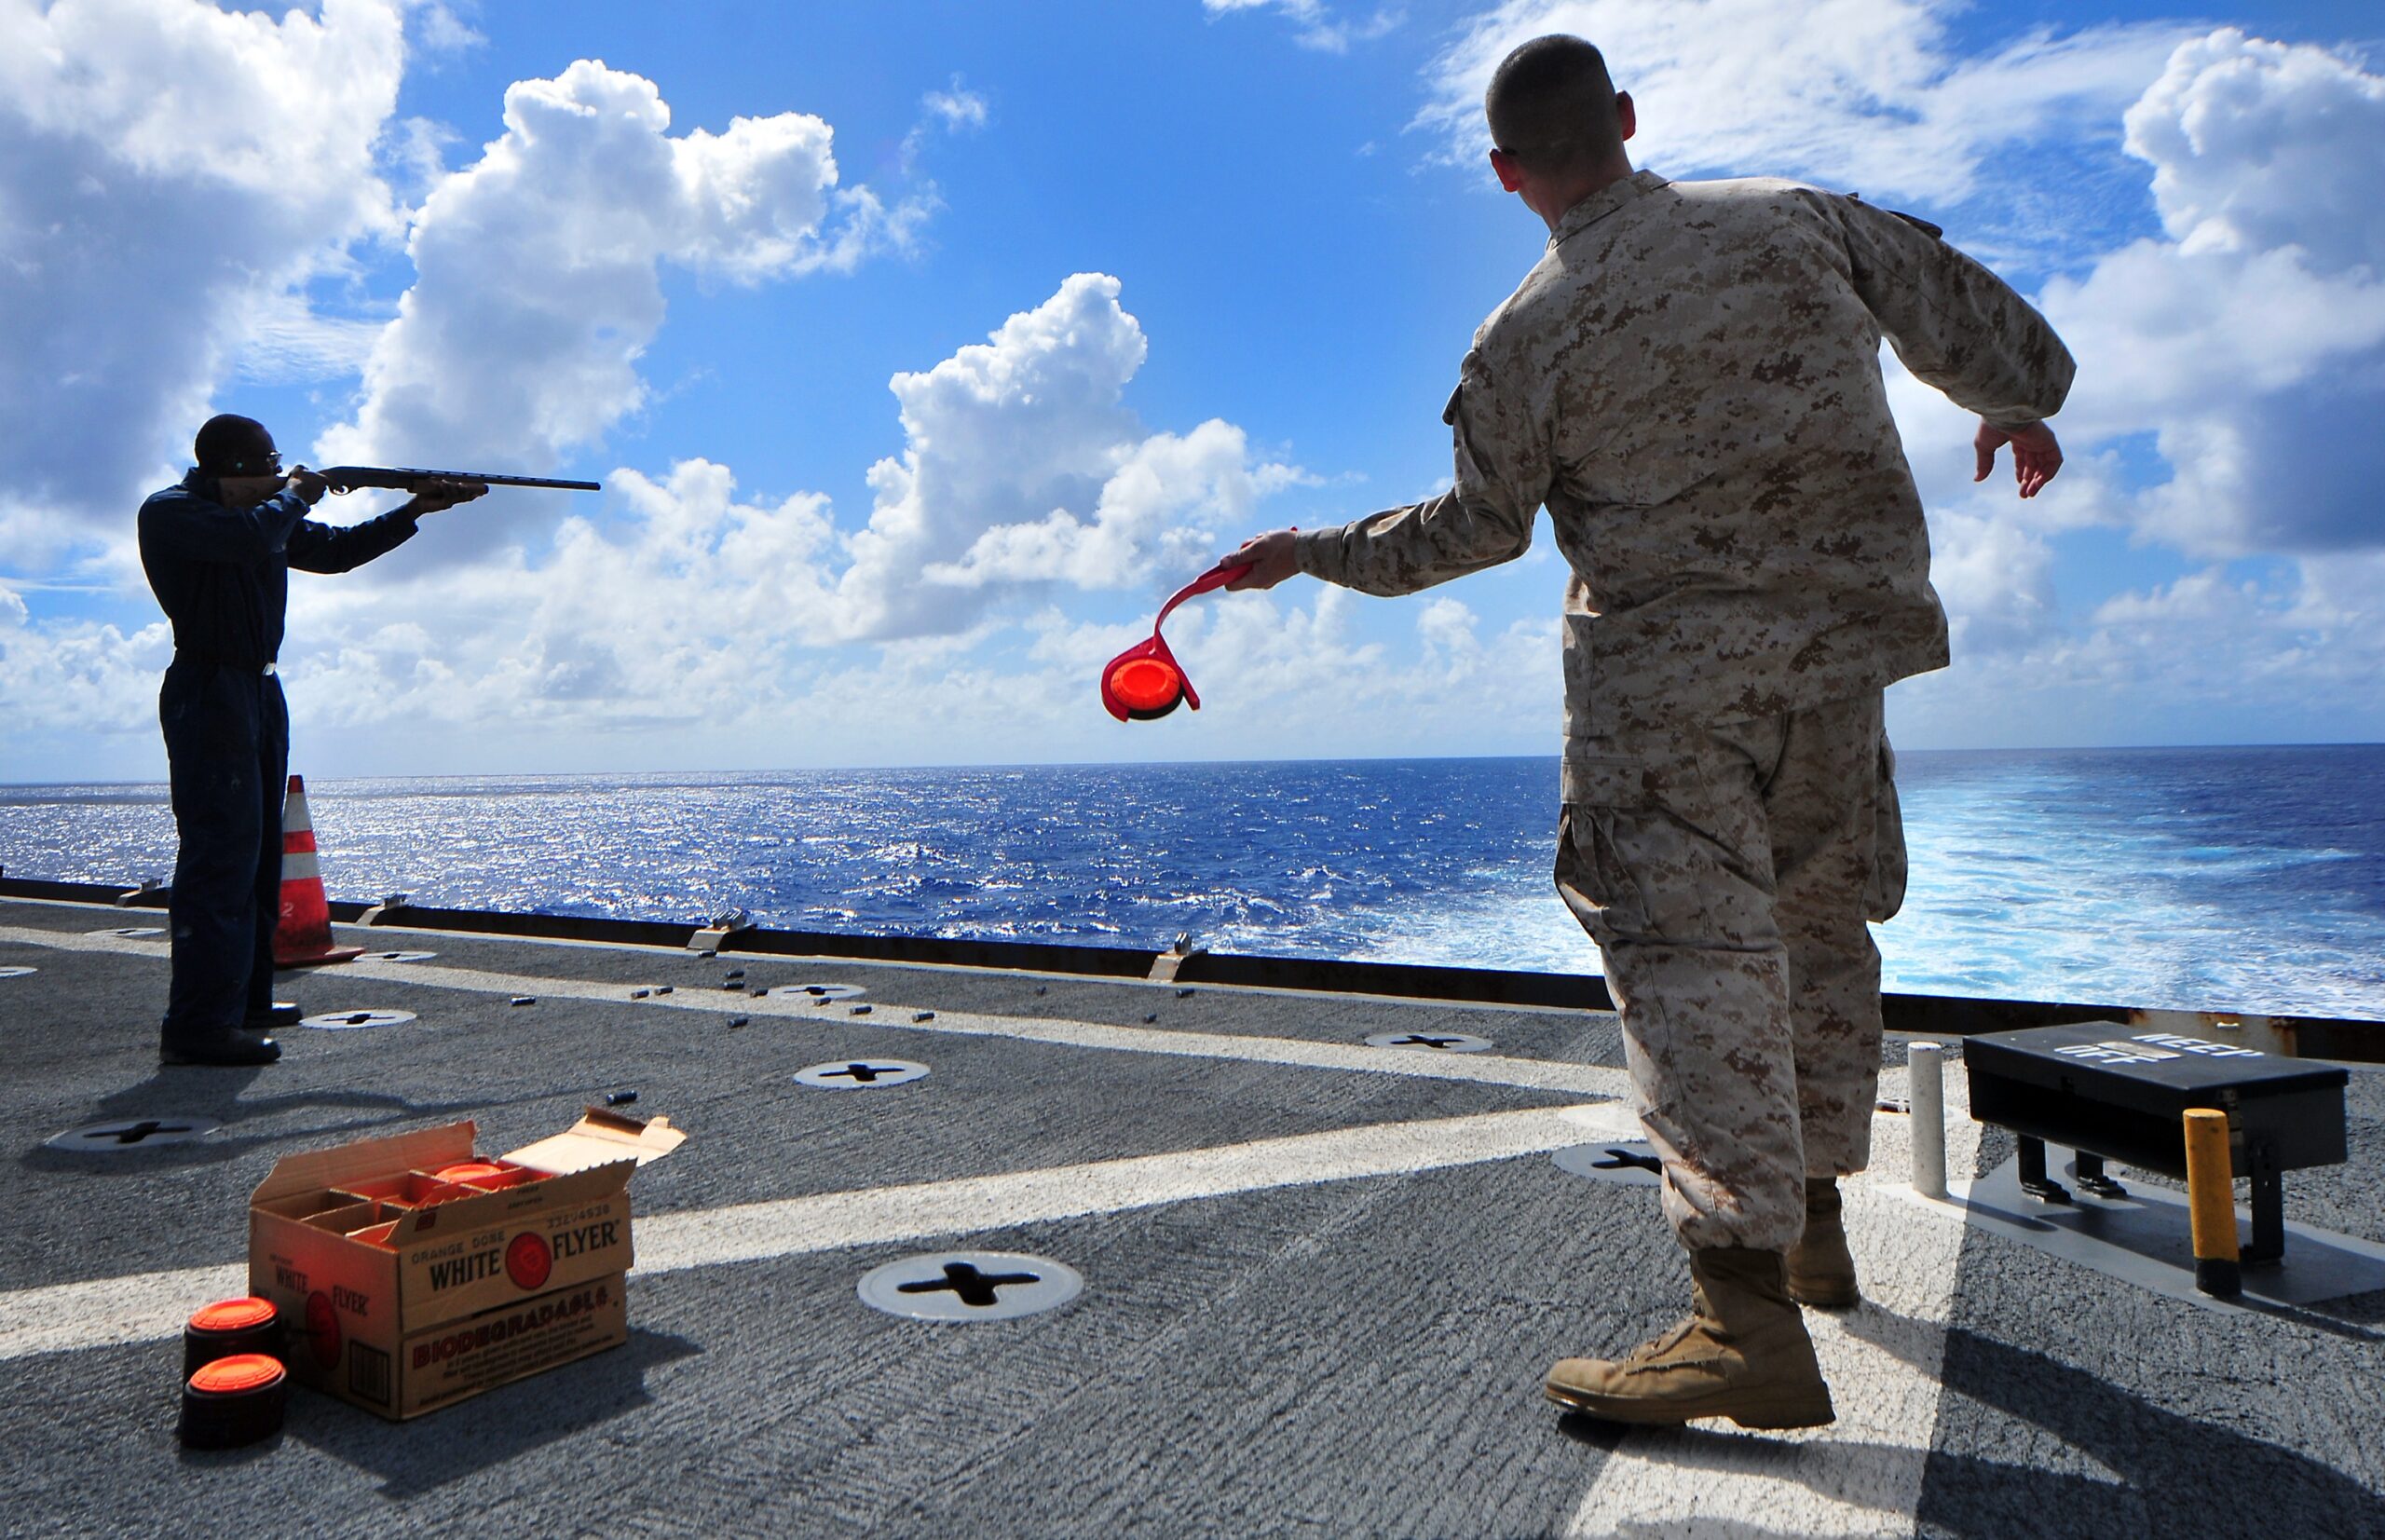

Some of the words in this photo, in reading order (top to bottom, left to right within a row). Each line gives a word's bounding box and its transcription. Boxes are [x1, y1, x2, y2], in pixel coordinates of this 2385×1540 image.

[2053, 1044, 2160, 1064] OFF
[2131, 1032, 2265, 1056] KEEP
[411, 1240, 464, 1264] ORANGE
[472, 1231, 505, 1248] DOME
[429, 1248, 500, 1291] WHITE
[276, 1266, 309, 1295] WHITE
[333, 1285, 369, 1316] FLYER
[413, 1287, 608, 1370] BIODEGRADABLE
